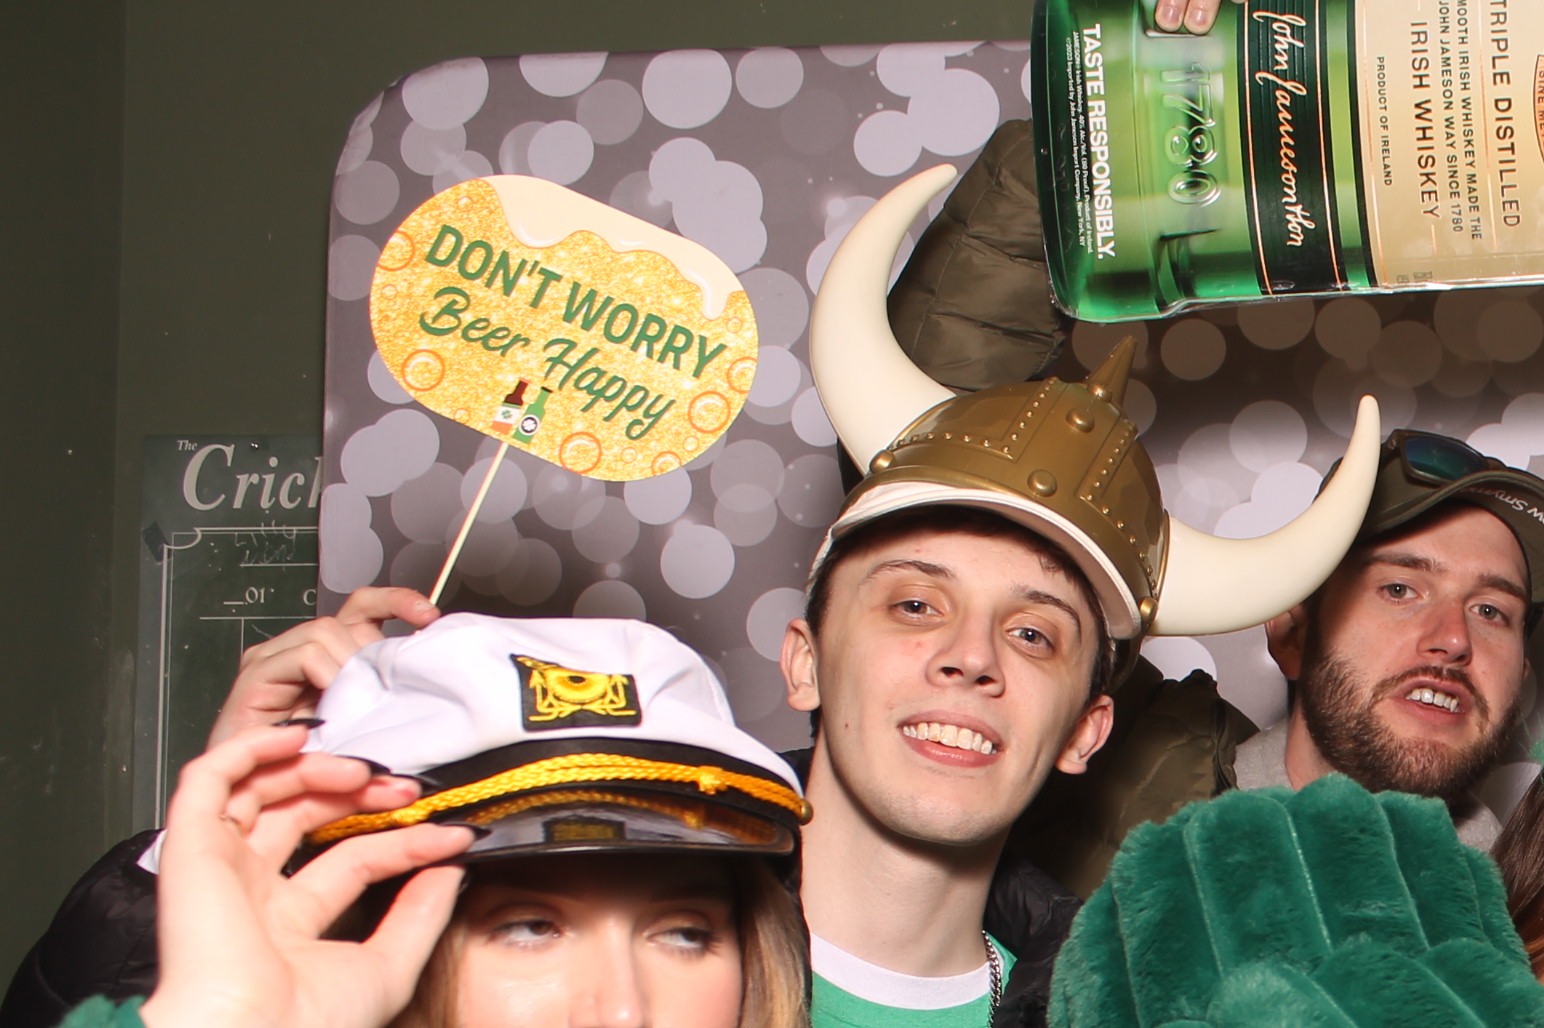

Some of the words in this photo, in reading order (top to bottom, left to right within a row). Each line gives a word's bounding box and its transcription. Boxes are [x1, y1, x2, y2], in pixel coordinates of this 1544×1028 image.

[1253, 11, 1306, 70] John
[1439, 0, 1450, 34] JOHN
[1490, 0, 1511, 86] TRIPLE
[1083, 24, 1105, 96] TASTE
[1377, 56, 1388, 112] PRODUCT
[1410, 22, 1431, 89] IRISH
[1440, 39, 1454, 110] JAMESON
[1458, 50, 1471, 91] IRISH
[1066, 62, 1074, 91] Imported
[1072, 146, 1080, 168] Import
[1080, 236, 1086, 246] NY
[1160, 62, 1222, 207] 1780
[1380, 116, 1388, 131] OF
[1444, 116, 1456, 150] WAY
[1461, 97, 1476, 168] WHISKEY
[1088, 100, 1116, 259] RESPONSIBLY.
[1380, 135, 1392, 186] IRELAND
[1414, 98, 1440, 218] WHISKEY
[1446, 154, 1460, 200] SINCE
[1494, 97, 1521, 227] DISTILLED
[1451, 204, 1463, 232] 1780
[1466, 173, 1480, 213] MADE
[1470, 218, 1482, 240] THE
[424, 224, 562, 309] DON'T
[562, 281, 728, 379] WORRY
[419, 286, 531, 358] Beer
[543, 338, 676, 441] Happy
[177, 440, 198, 451] The
